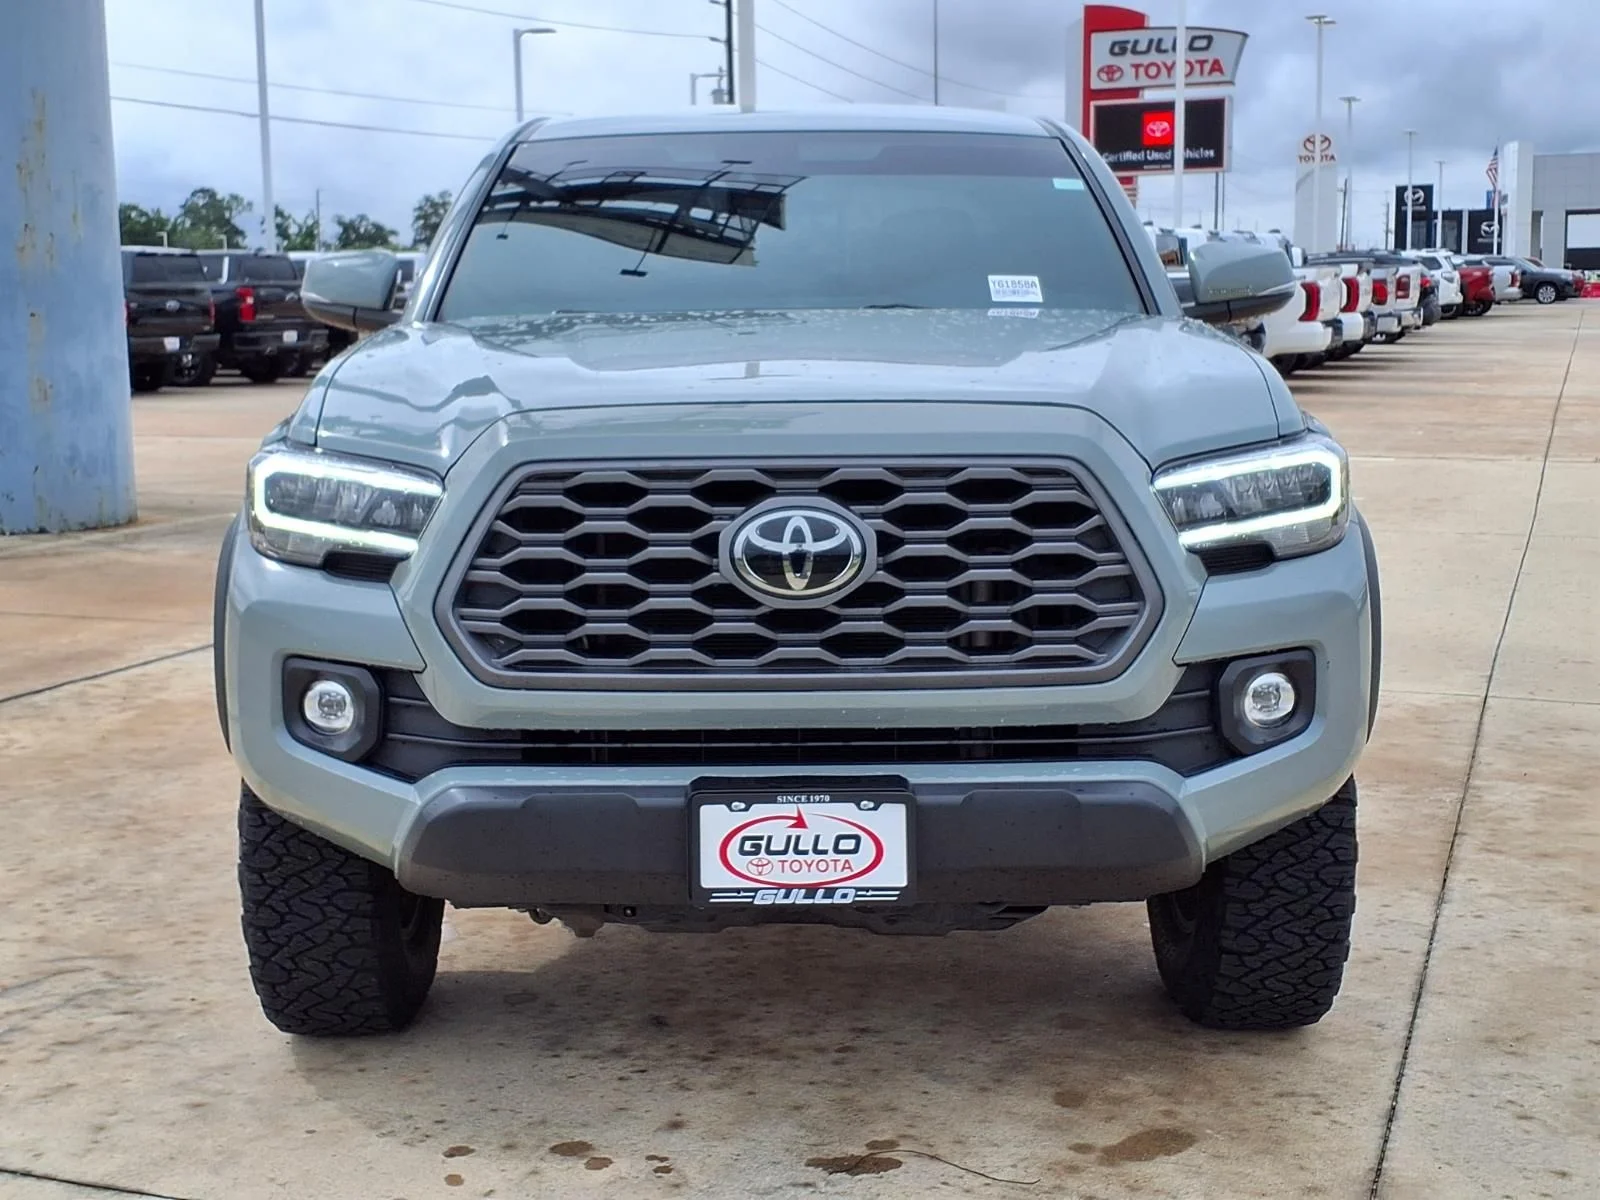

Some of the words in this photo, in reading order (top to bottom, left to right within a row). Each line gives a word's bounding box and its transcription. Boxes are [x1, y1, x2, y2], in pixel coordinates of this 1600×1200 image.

[1130, 58, 1225, 80] TOYOTA
[1102, 149, 1145, 162] Certified
[1146, 149, 1172, 160] Used
[1177, 147, 1215, 160] hicles
[777, 795, 808, 803] SINCE
[810, 795, 831, 803] 1970
[738, 834, 862, 856] GULLO
[778, 859, 854, 873] TOYOTA
[754, 888, 856, 904] GULLO
